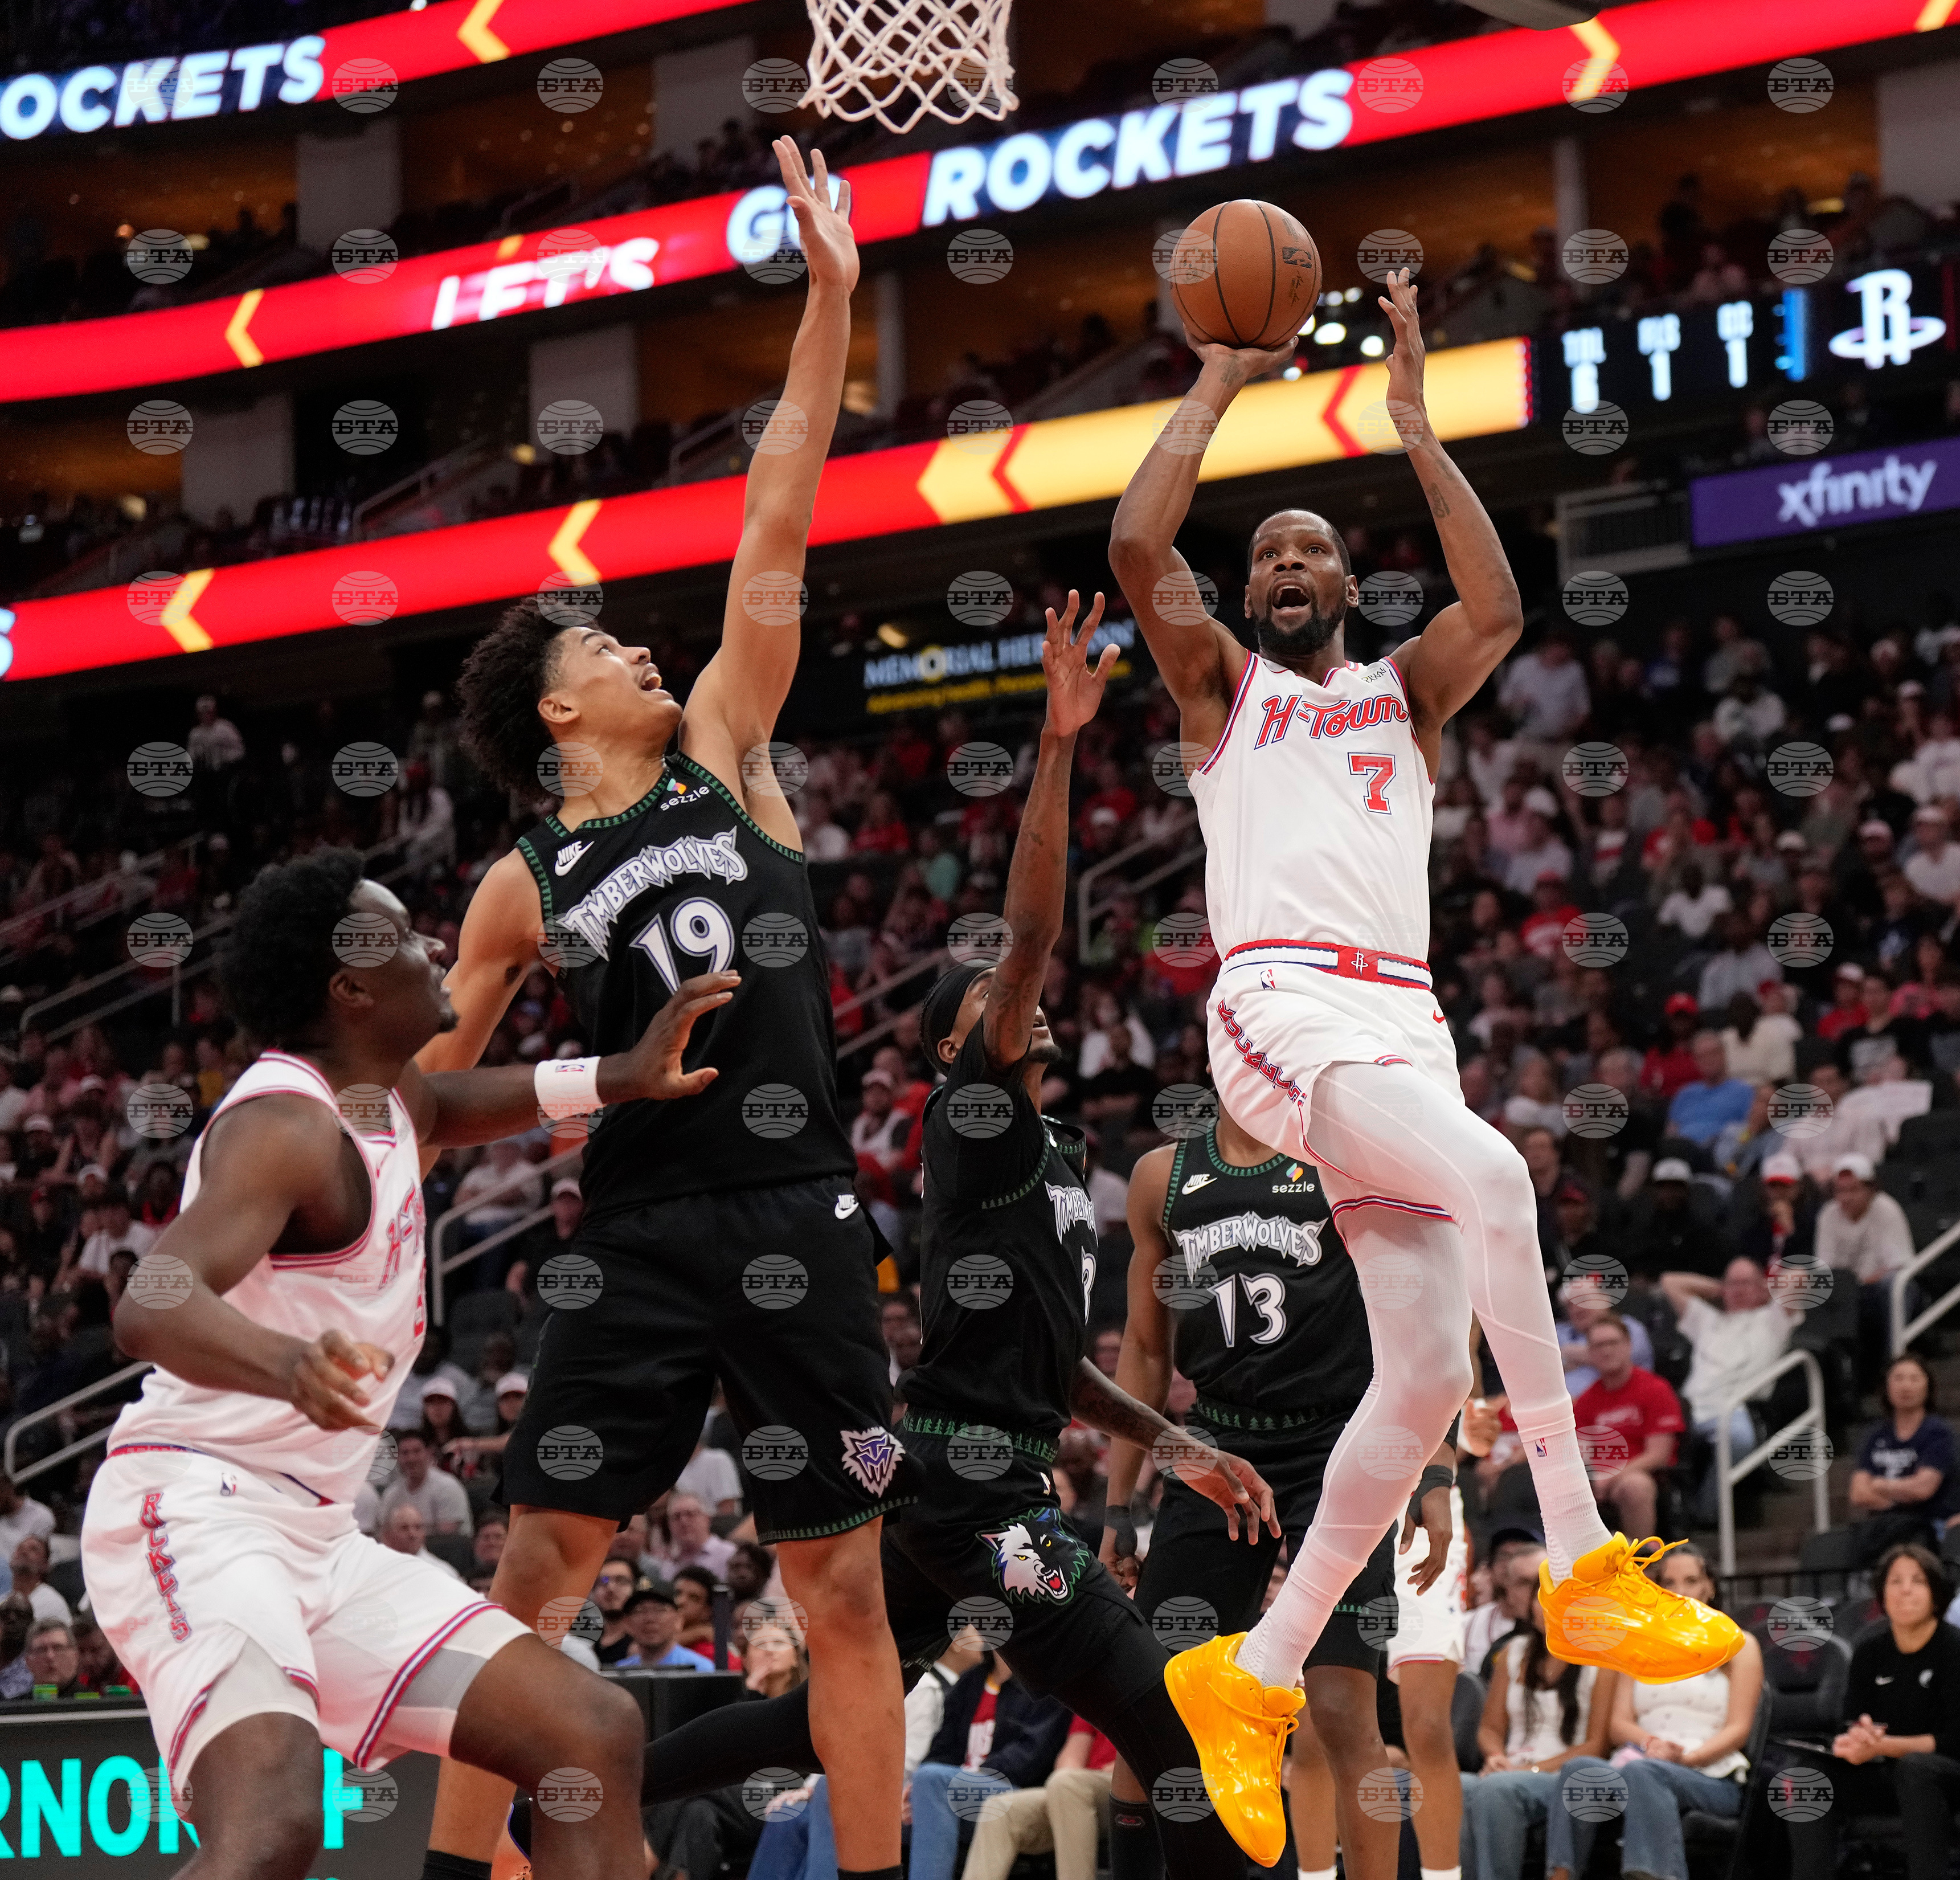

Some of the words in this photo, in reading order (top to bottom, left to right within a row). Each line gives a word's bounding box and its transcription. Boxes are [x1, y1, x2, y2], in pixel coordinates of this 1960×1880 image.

[922, 69, 1354, 227] ROCKETS
[1778, 455, 1937, 526] xfinity
[1254, 694, 1409, 750] H-Town
[660, 785, 710, 812] sezzle
[1347, 752, 1396, 815] 7
[557, 840, 583, 865] NIKE
[556, 825, 748, 962] TIMBERWOLVES
[629, 897, 735, 996] 19
[1216, 997, 1302, 1104] ROCKETS
[1186, 1174, 1210, 1187] NIKE
[1272, 1181, 1315, 1194] sezzle
[1172, 1211, 1329, 1284] TIMBERWOLVES
[1207, 1273, 1287, 1348] 13
